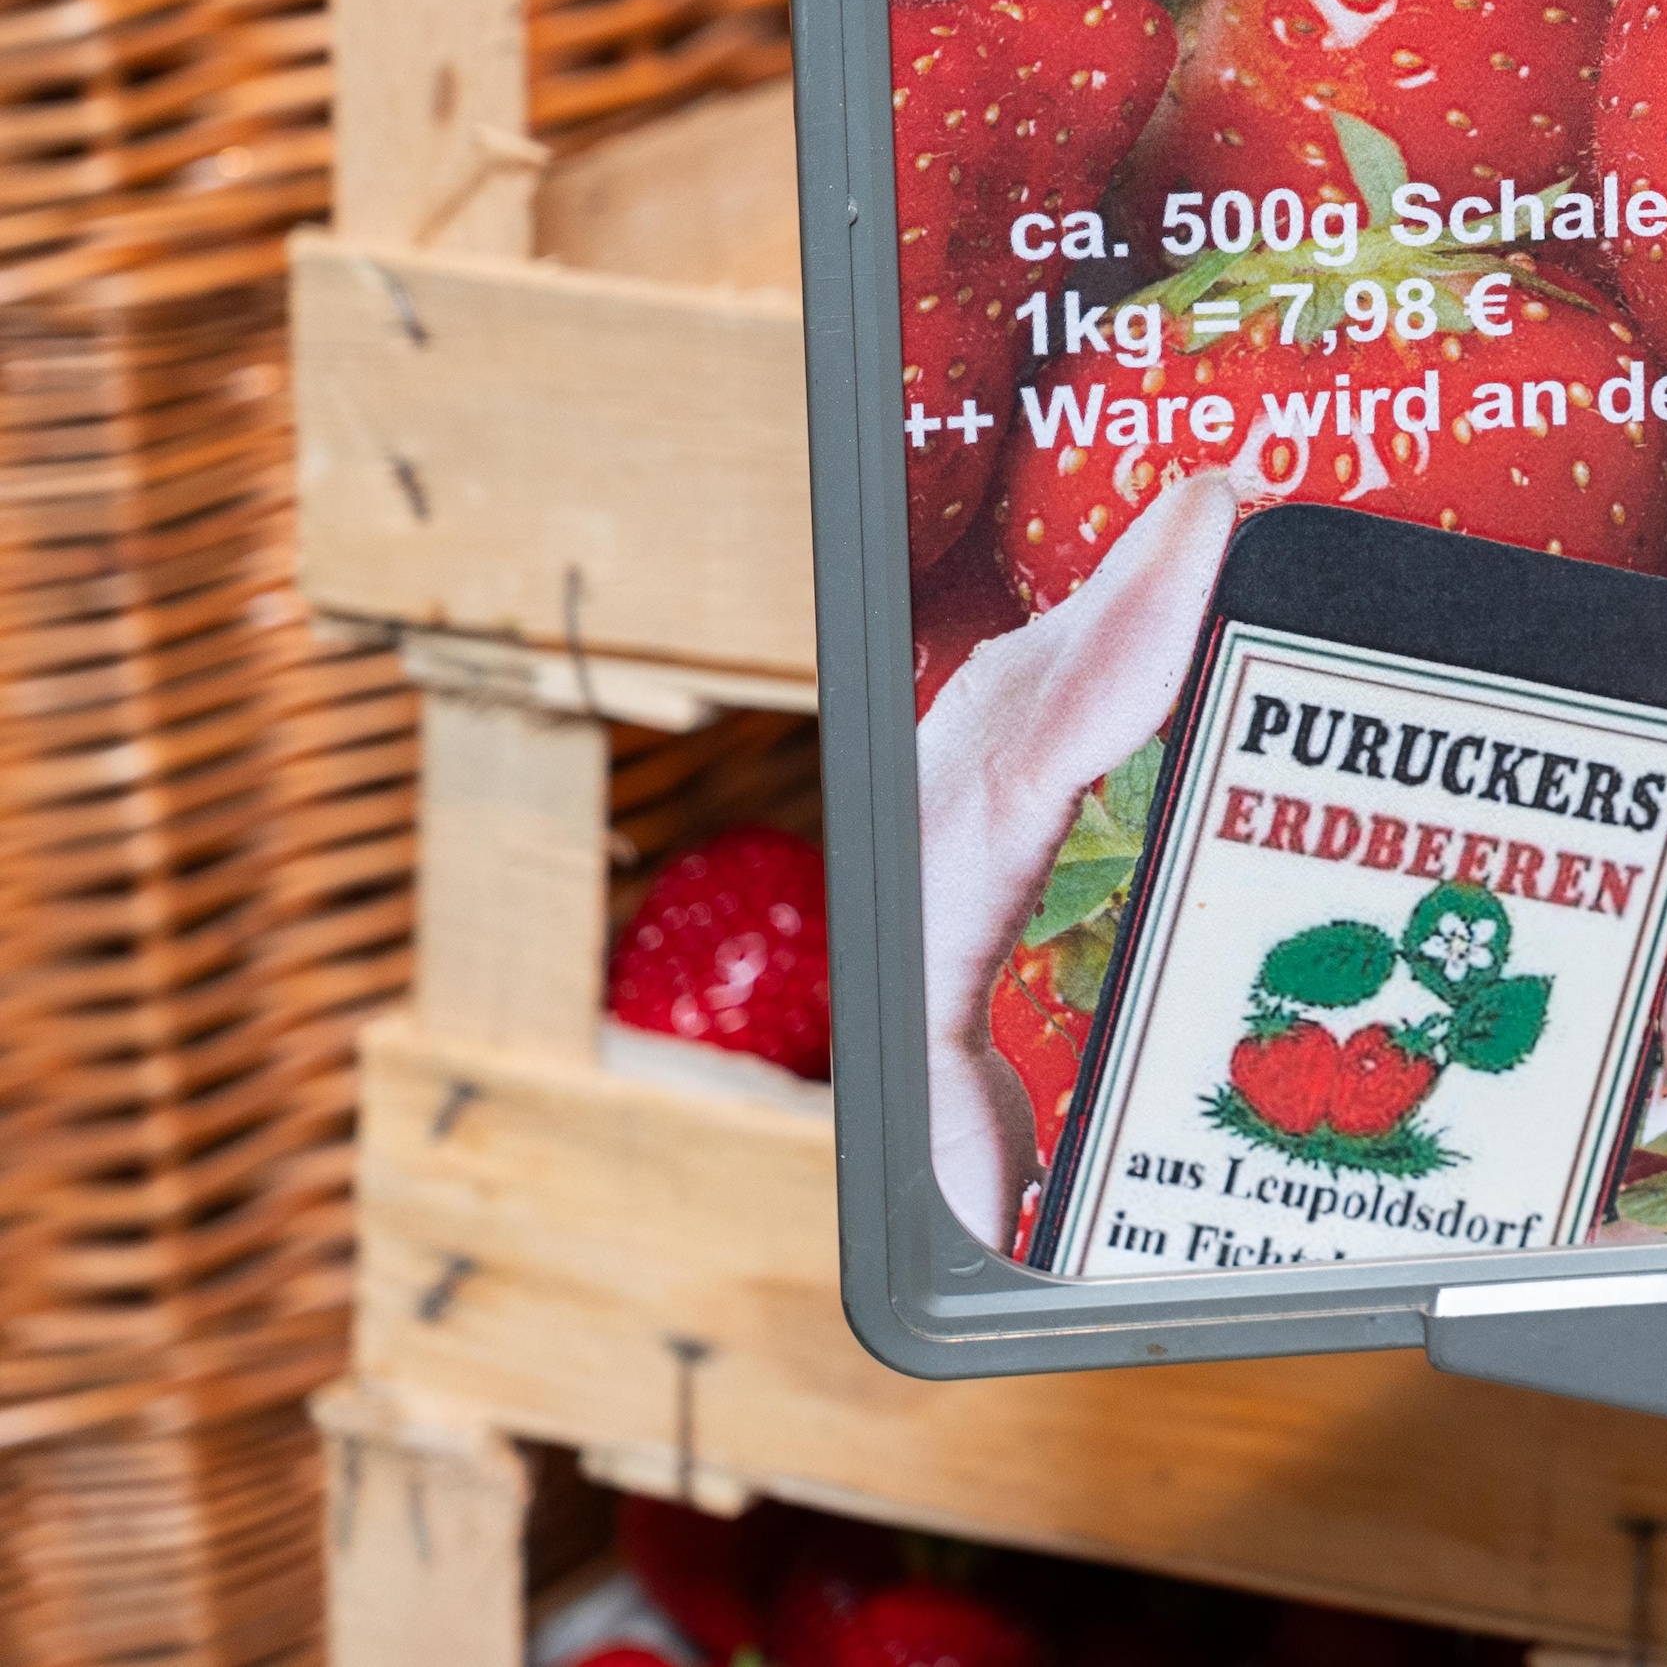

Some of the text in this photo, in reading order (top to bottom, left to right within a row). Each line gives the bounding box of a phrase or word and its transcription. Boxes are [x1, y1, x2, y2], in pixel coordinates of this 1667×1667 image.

[1009, 210, 1130, 262] ca.
[1161, 186, 1360, 267] 500g
[1013, 272, 1514, 368] 1kg = 7,98 €
[904, 399, 994, 448] ++
[1018, 383, 1236, 451] Ware
[1260, 372, 1442, 439] wird
[1470, 380, 1569, 434] an
[1239, 693, 1667, 833] PURUCKERS
[1214, 785, 1645, 919] ERDBEEREN
[1107, 1210, 1167, 1256] im
[1126, 1151, 1542, 1249] aus Leupoldsdorf
